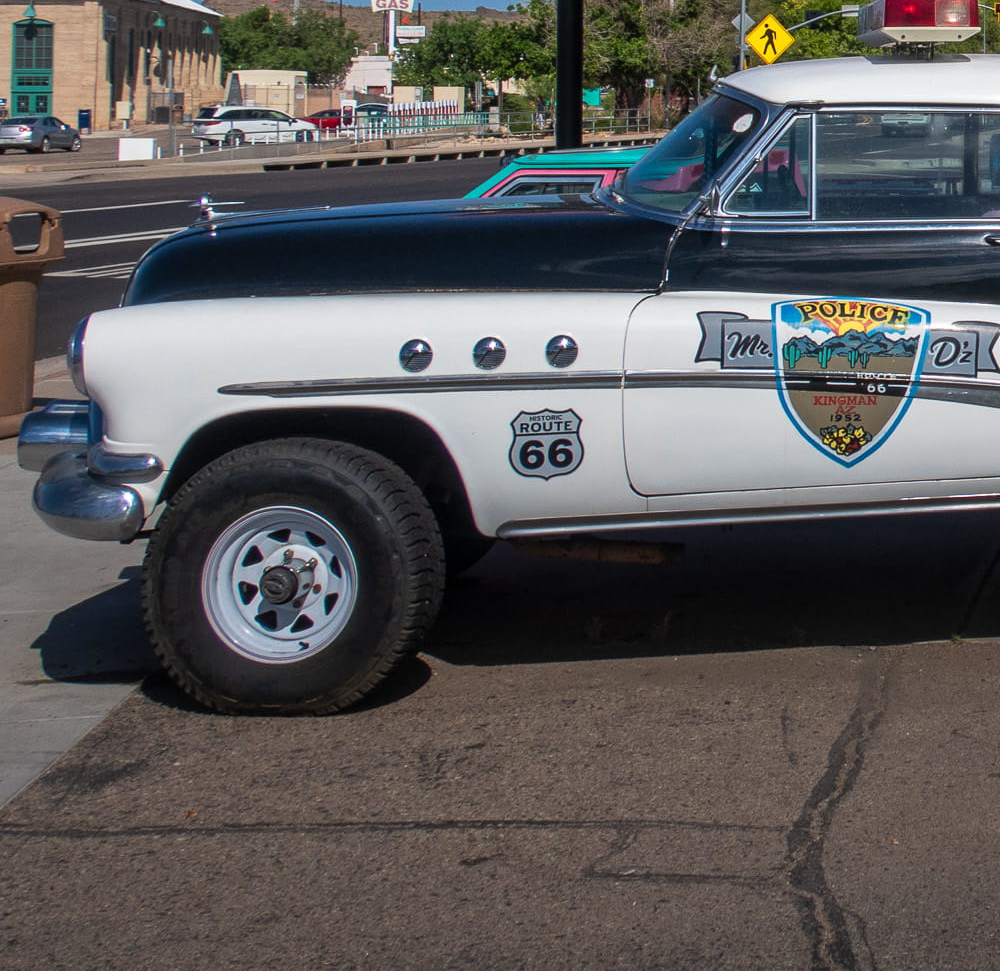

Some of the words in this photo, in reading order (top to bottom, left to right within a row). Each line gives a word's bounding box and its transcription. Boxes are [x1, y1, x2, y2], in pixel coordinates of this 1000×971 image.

[376, 0, 409, 9] GAS
[798, 301, 909, 324] POLICE
[726, 331, 774, 359] Mr.
[930, 337, 974, 366] D'z
[866, 383, 886, 394] 66
[813, 395, 878, 407] KINGMAN
[835, 406, 857, 415] AZ
[829, 414, 862, 422] 1952
[519, 421, 573, 433] ROUTE
[519, 438, 574, 469] 66
